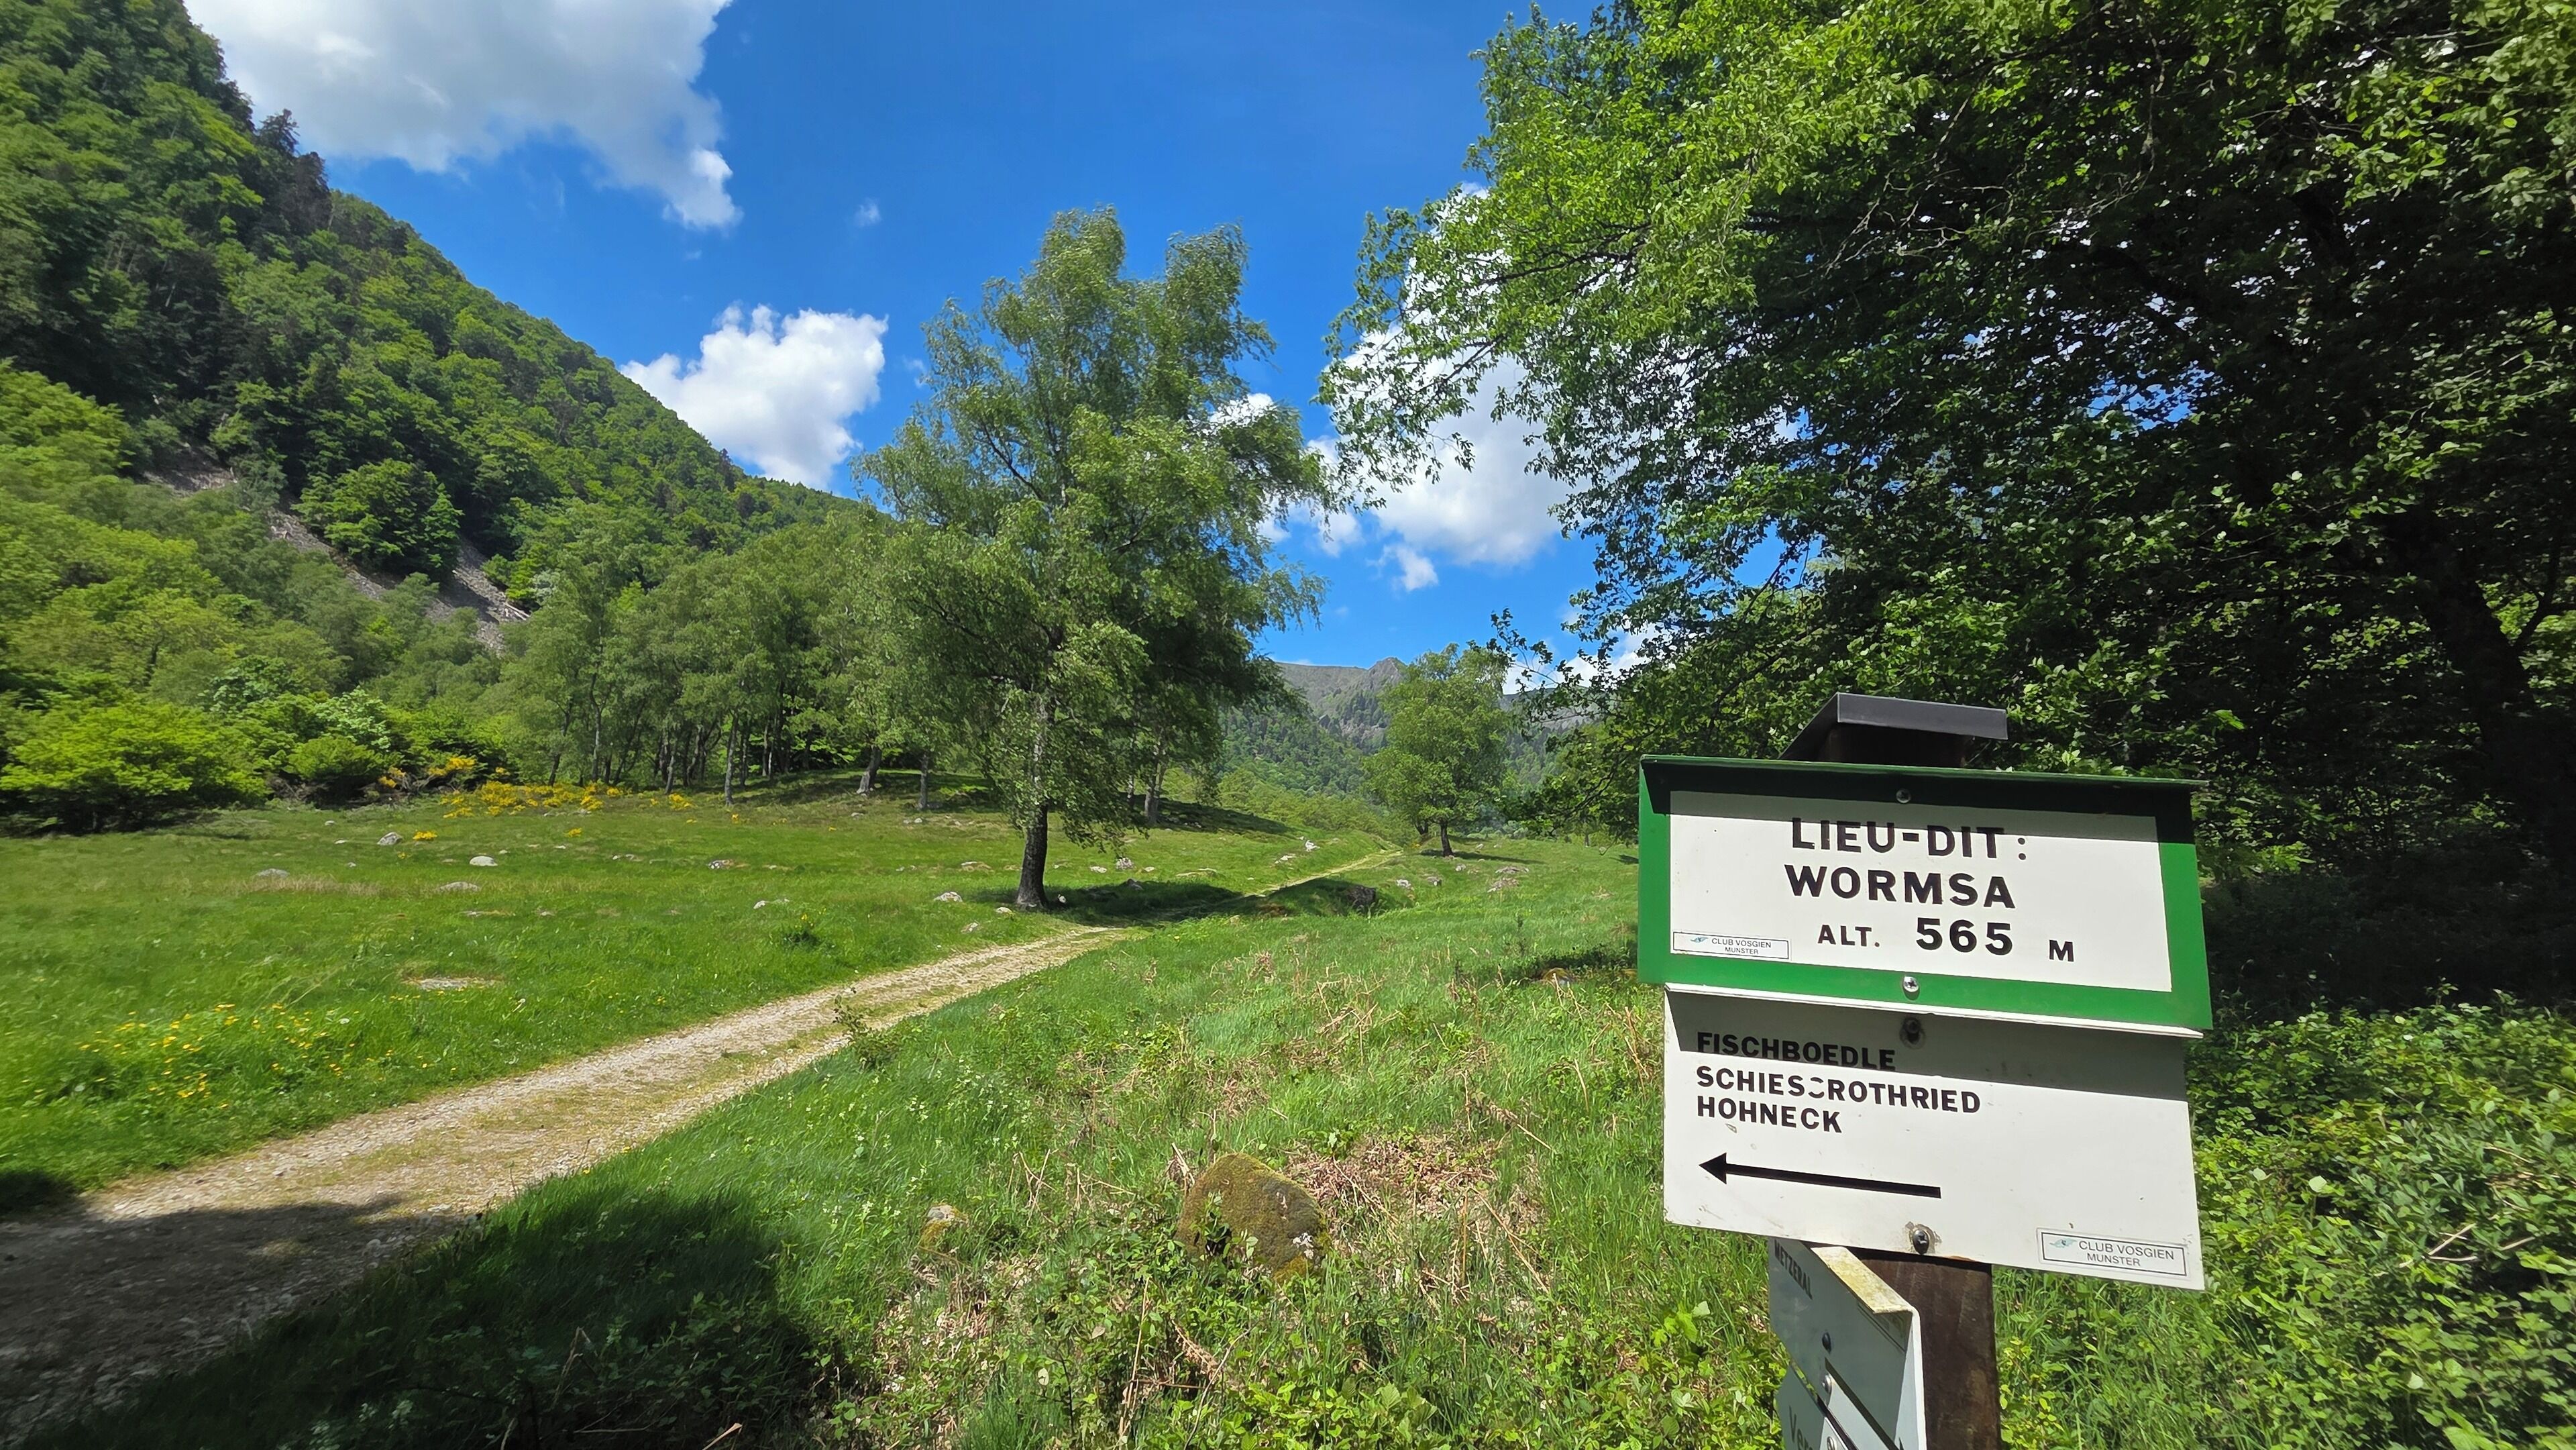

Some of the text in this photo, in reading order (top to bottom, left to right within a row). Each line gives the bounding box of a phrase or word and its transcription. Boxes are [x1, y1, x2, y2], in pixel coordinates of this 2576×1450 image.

[1784, 864, 2015, 909] WORMSA
[1711, 937, 1772, 948] CLUB VOSGIEN
[1725, 947, 1759, 955] MUNSTER
[1817, 917, 2075, 962] ALT. 565 M
[1697, 1031, 1896, 1072] FISCHBOEDLE
[1697, 1095, 1842, 1133] HOHNECK
[2079, 1240, 2174, 1260] CLUB VOSGIEN
[2087, 1253, 2141, 1267] MUNSTER
[1774, 1239, 1813, 1300] METZERAL
